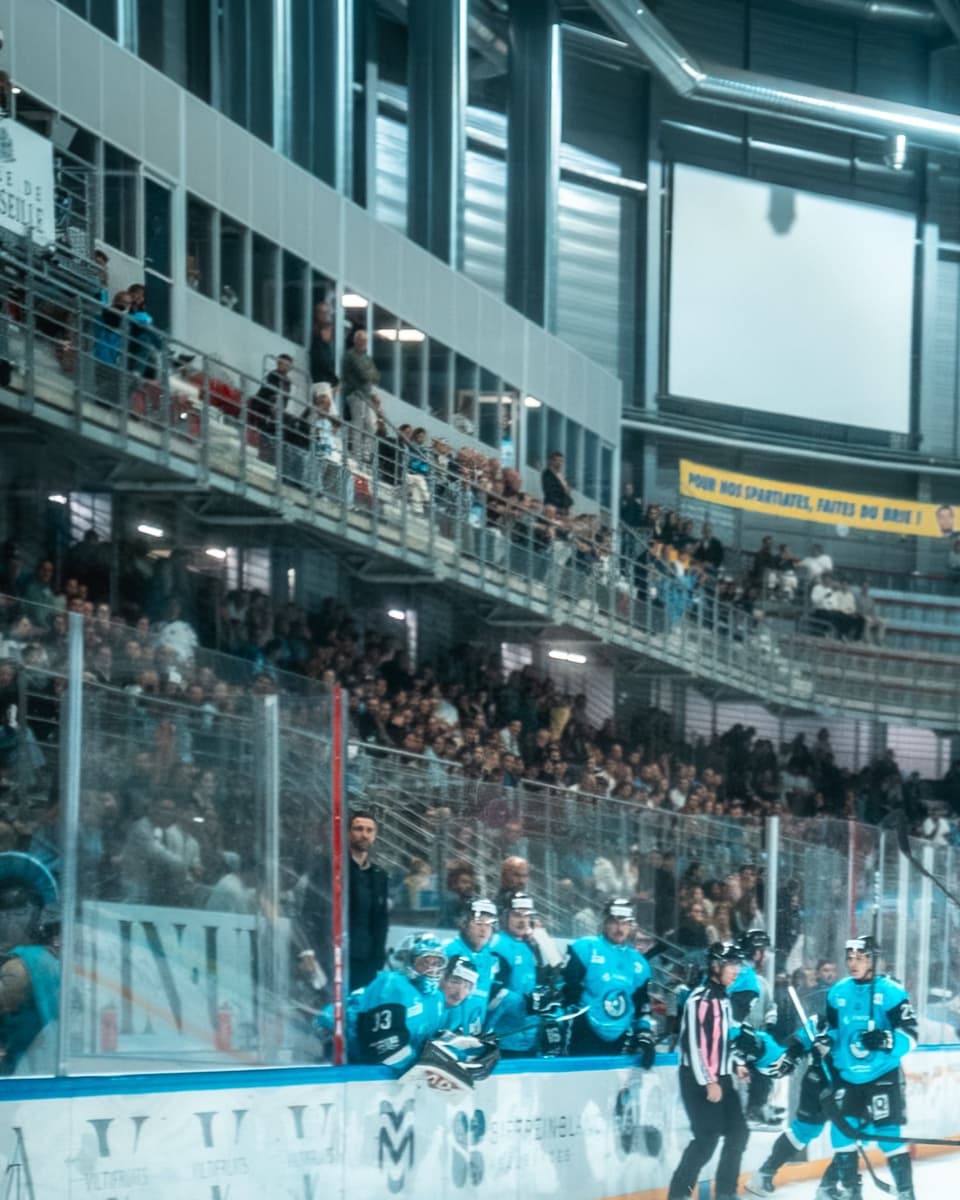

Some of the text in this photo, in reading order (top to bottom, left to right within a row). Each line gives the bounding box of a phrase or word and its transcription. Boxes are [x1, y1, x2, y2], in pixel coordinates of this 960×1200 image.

[0, 189, 44, 234] SEILLE
[688, 472, 717, 492] POUR
[719, 480, 743, 499] NOS
[744, 484, 812, 512] SPARTIATES,
[816, 498, 857, 518] FAITES
[860, 505, 879, 520] DU
[883, 508, 912, 525] BRIE
